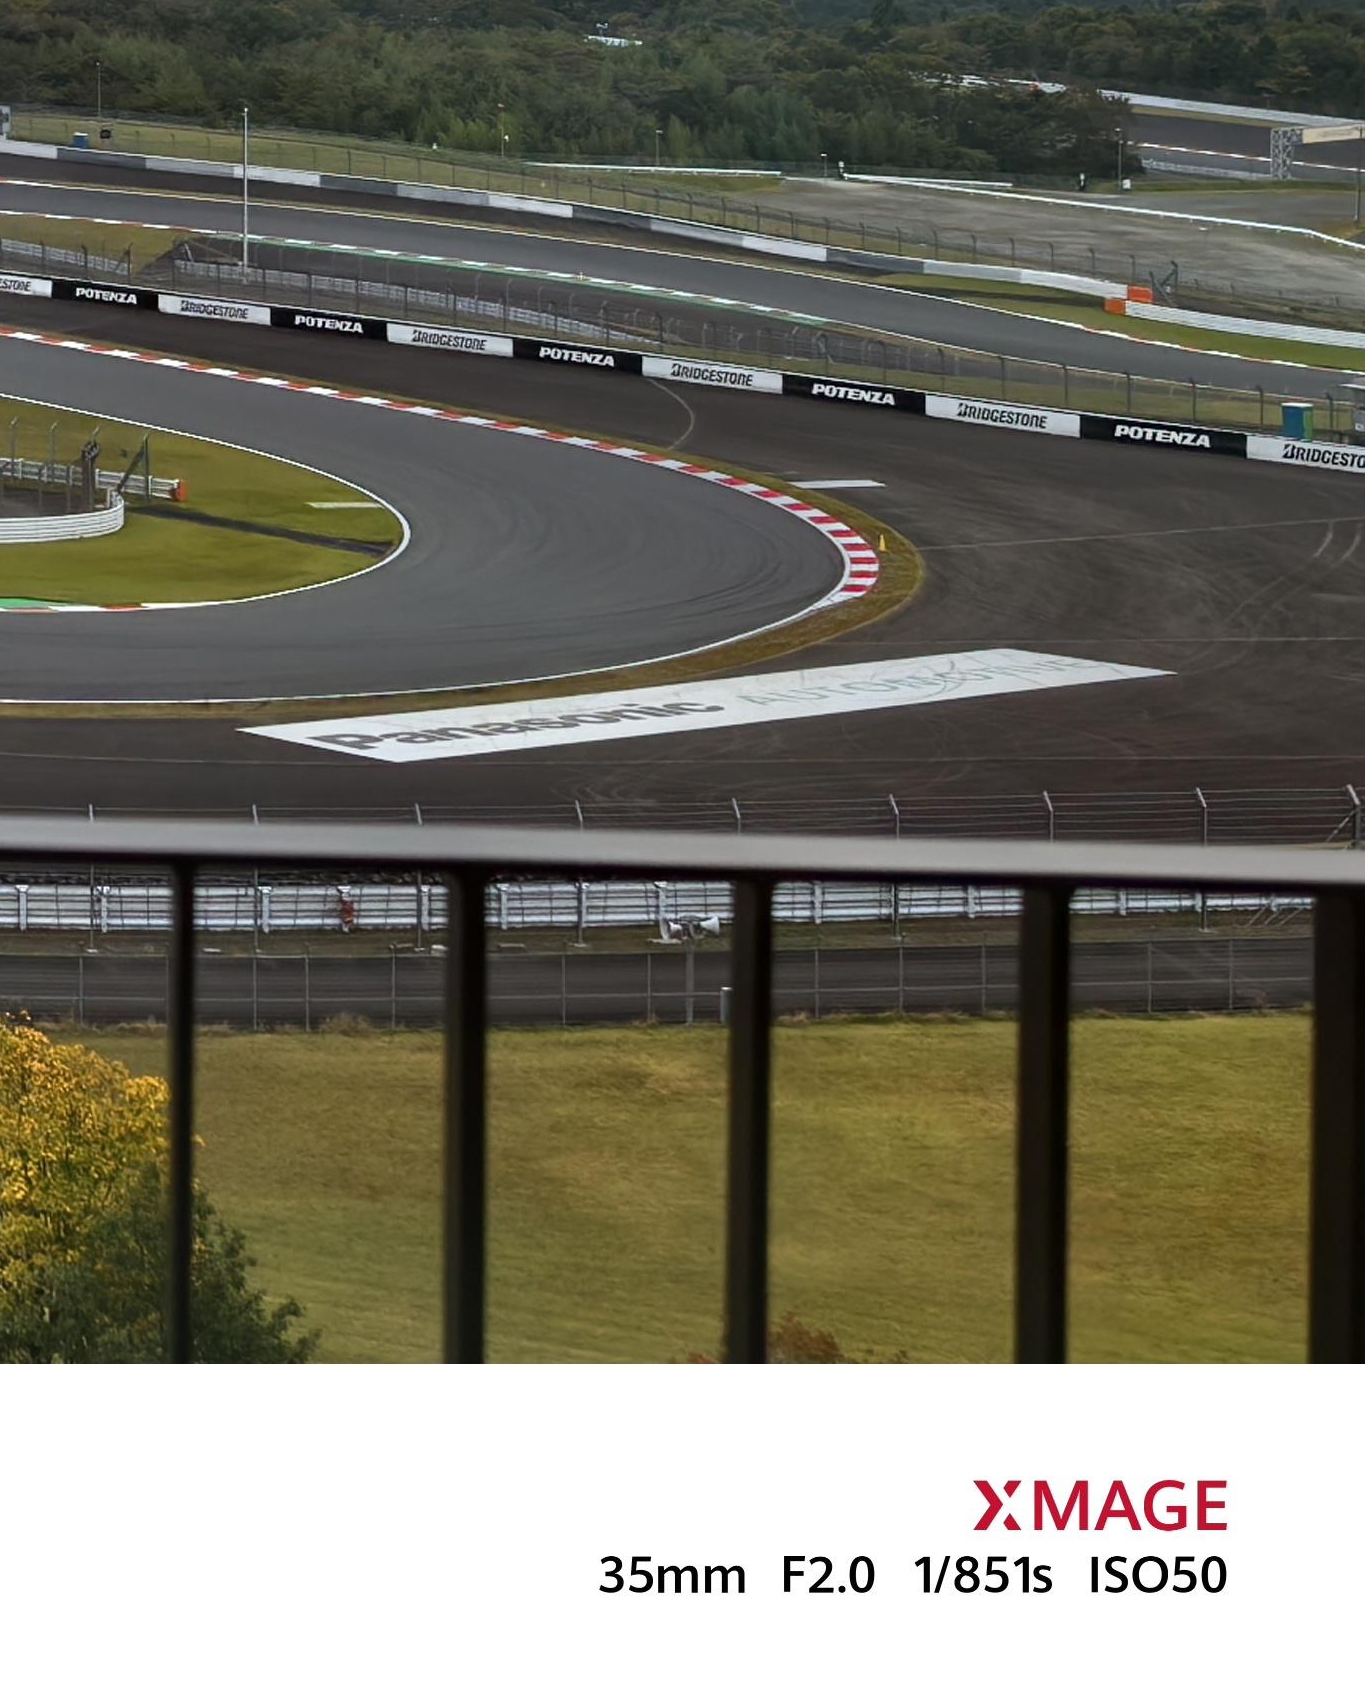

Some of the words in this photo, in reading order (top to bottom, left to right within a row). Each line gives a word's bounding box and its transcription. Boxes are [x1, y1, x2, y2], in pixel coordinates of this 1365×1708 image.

[76, 287, 137, 305] POTENZA
[181, 299, 249, 319] BRIDGESTONE
[295, 315, 364, 334] POTENZA
[412, 329, 486, 352] BRIDGESTONE
[539, 346, 615, 367] POTENZA
[670, 363, 754, 387] BRIDGESTONE
[812, 383, 896, 406] POTENZA
[957, 402, 1048, 429] BRIDGESTONE
[1114, 424, 1211, 448] POTENZA
[309, 699, 725, 750] Panasonic
